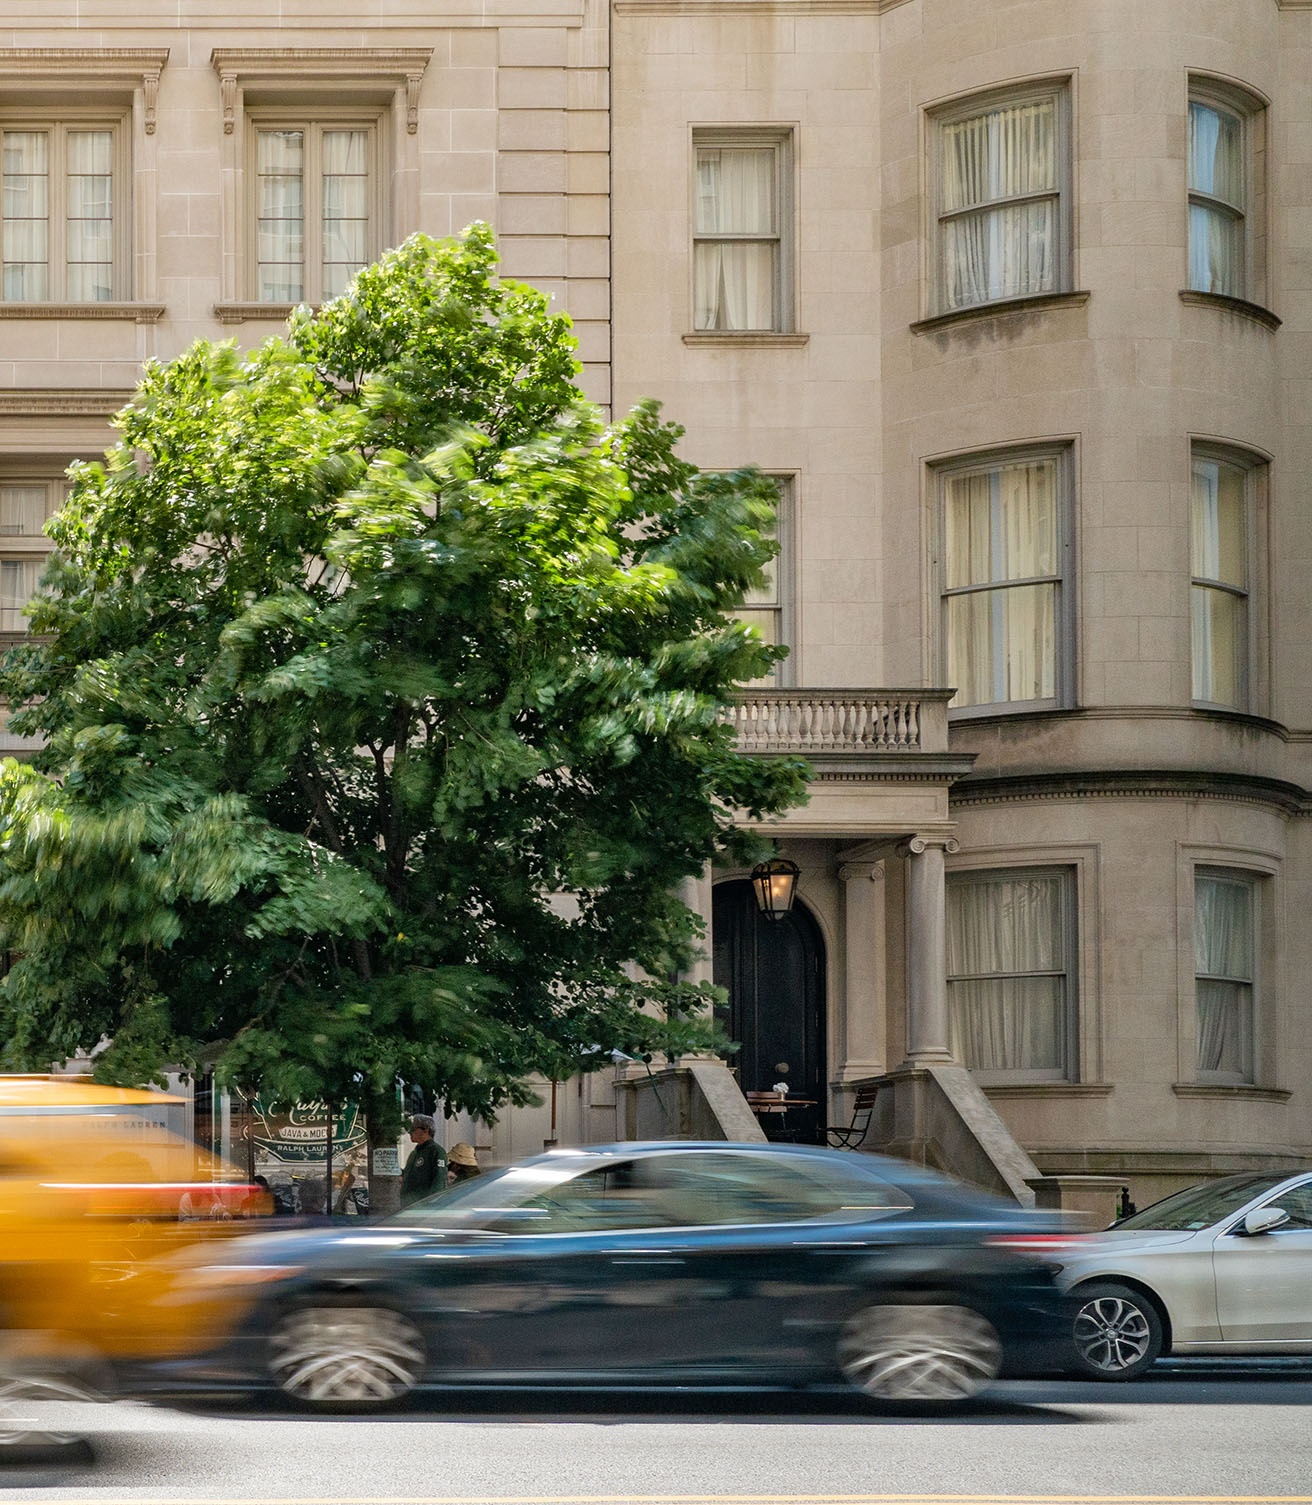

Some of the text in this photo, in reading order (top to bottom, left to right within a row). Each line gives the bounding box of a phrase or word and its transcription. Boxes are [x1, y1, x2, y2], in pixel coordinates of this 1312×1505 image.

[123, 1121, 166, 1129] LAUREN
[281, 1128, 302, 1138] JAVA
[309, 1127, 336, 1138] MOCA
[277, 1144, 305, 1152] RALPH
